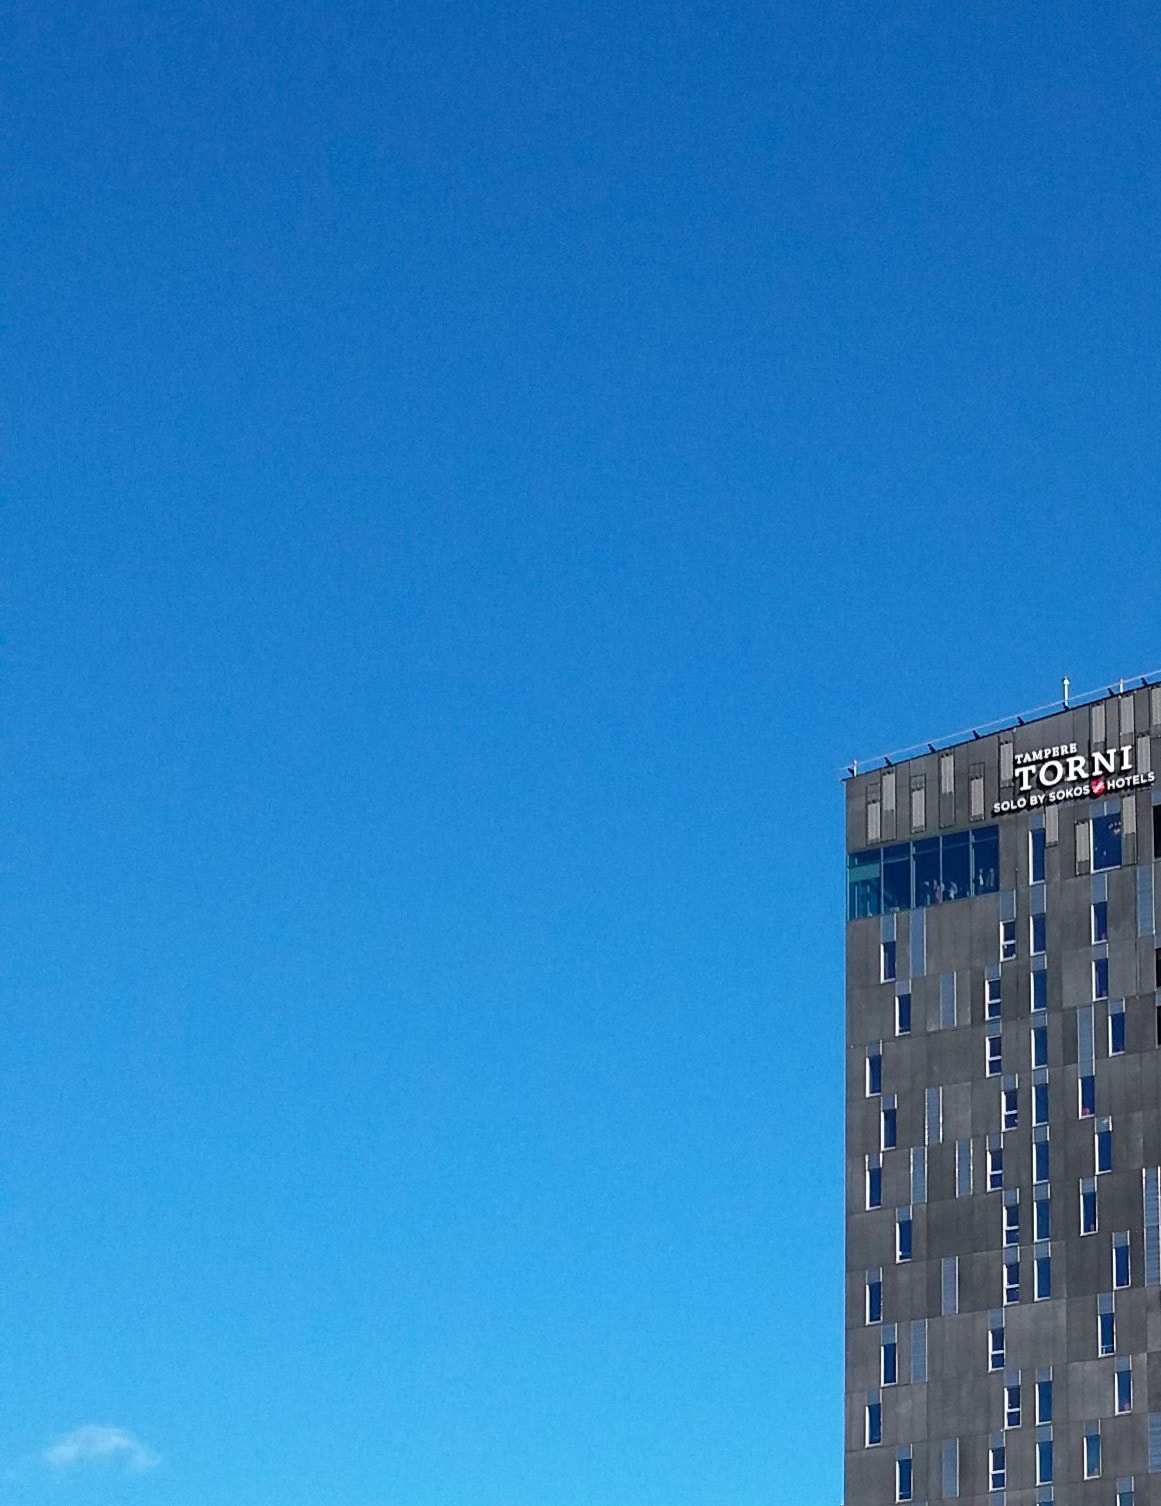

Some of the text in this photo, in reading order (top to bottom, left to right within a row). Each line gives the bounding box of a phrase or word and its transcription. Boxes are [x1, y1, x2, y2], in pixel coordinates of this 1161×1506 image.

[1014, 742, 1078, 764] TAMPERE
[1014, 745, 1133, 791] TORNI
[993, 771, 1156, 813] SOLO BY SOKOS HOTELS
